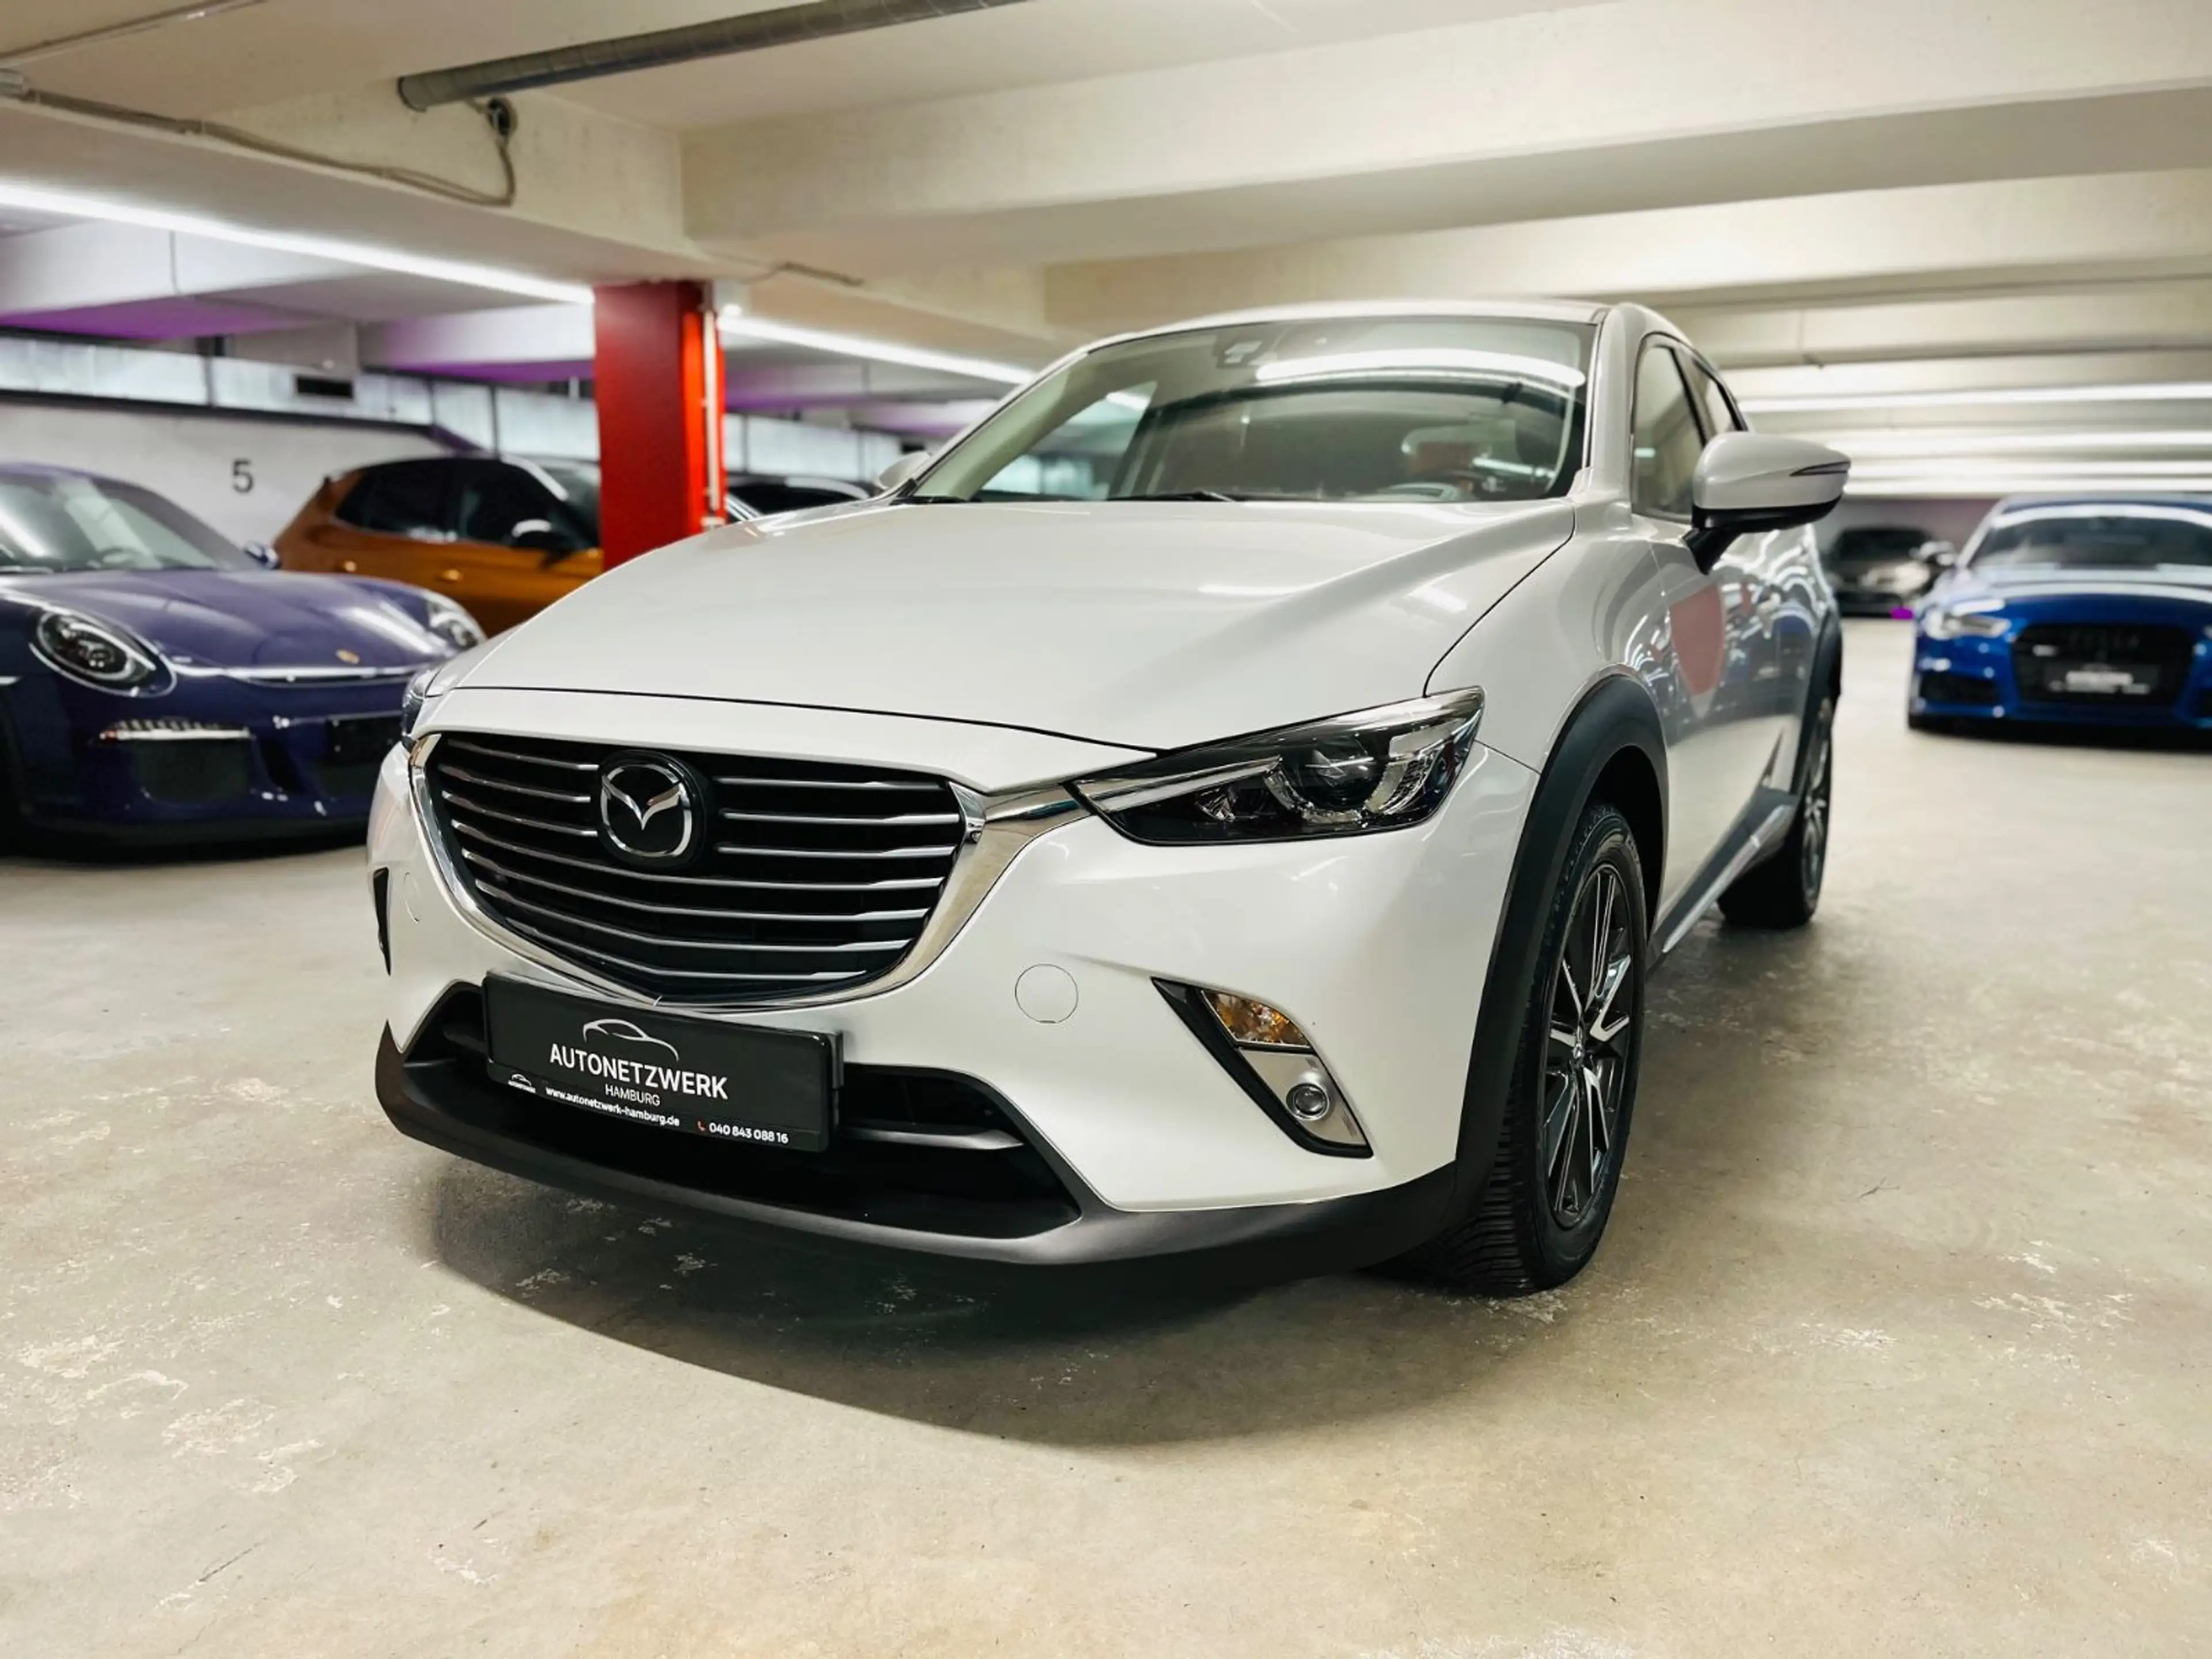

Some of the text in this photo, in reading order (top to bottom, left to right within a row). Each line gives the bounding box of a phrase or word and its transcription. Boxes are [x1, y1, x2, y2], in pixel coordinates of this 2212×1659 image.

[232, 458, 254, 494] 5
[550, 1043, 728, 1100] AUTONETZWERK
[546, 1087, 680, 1126] www.autonetzwerk-hamburg.de
[605, 1084, 661, 1107] HAMBURG
[709, 1122, 789, 1144] 040 843 088 16
